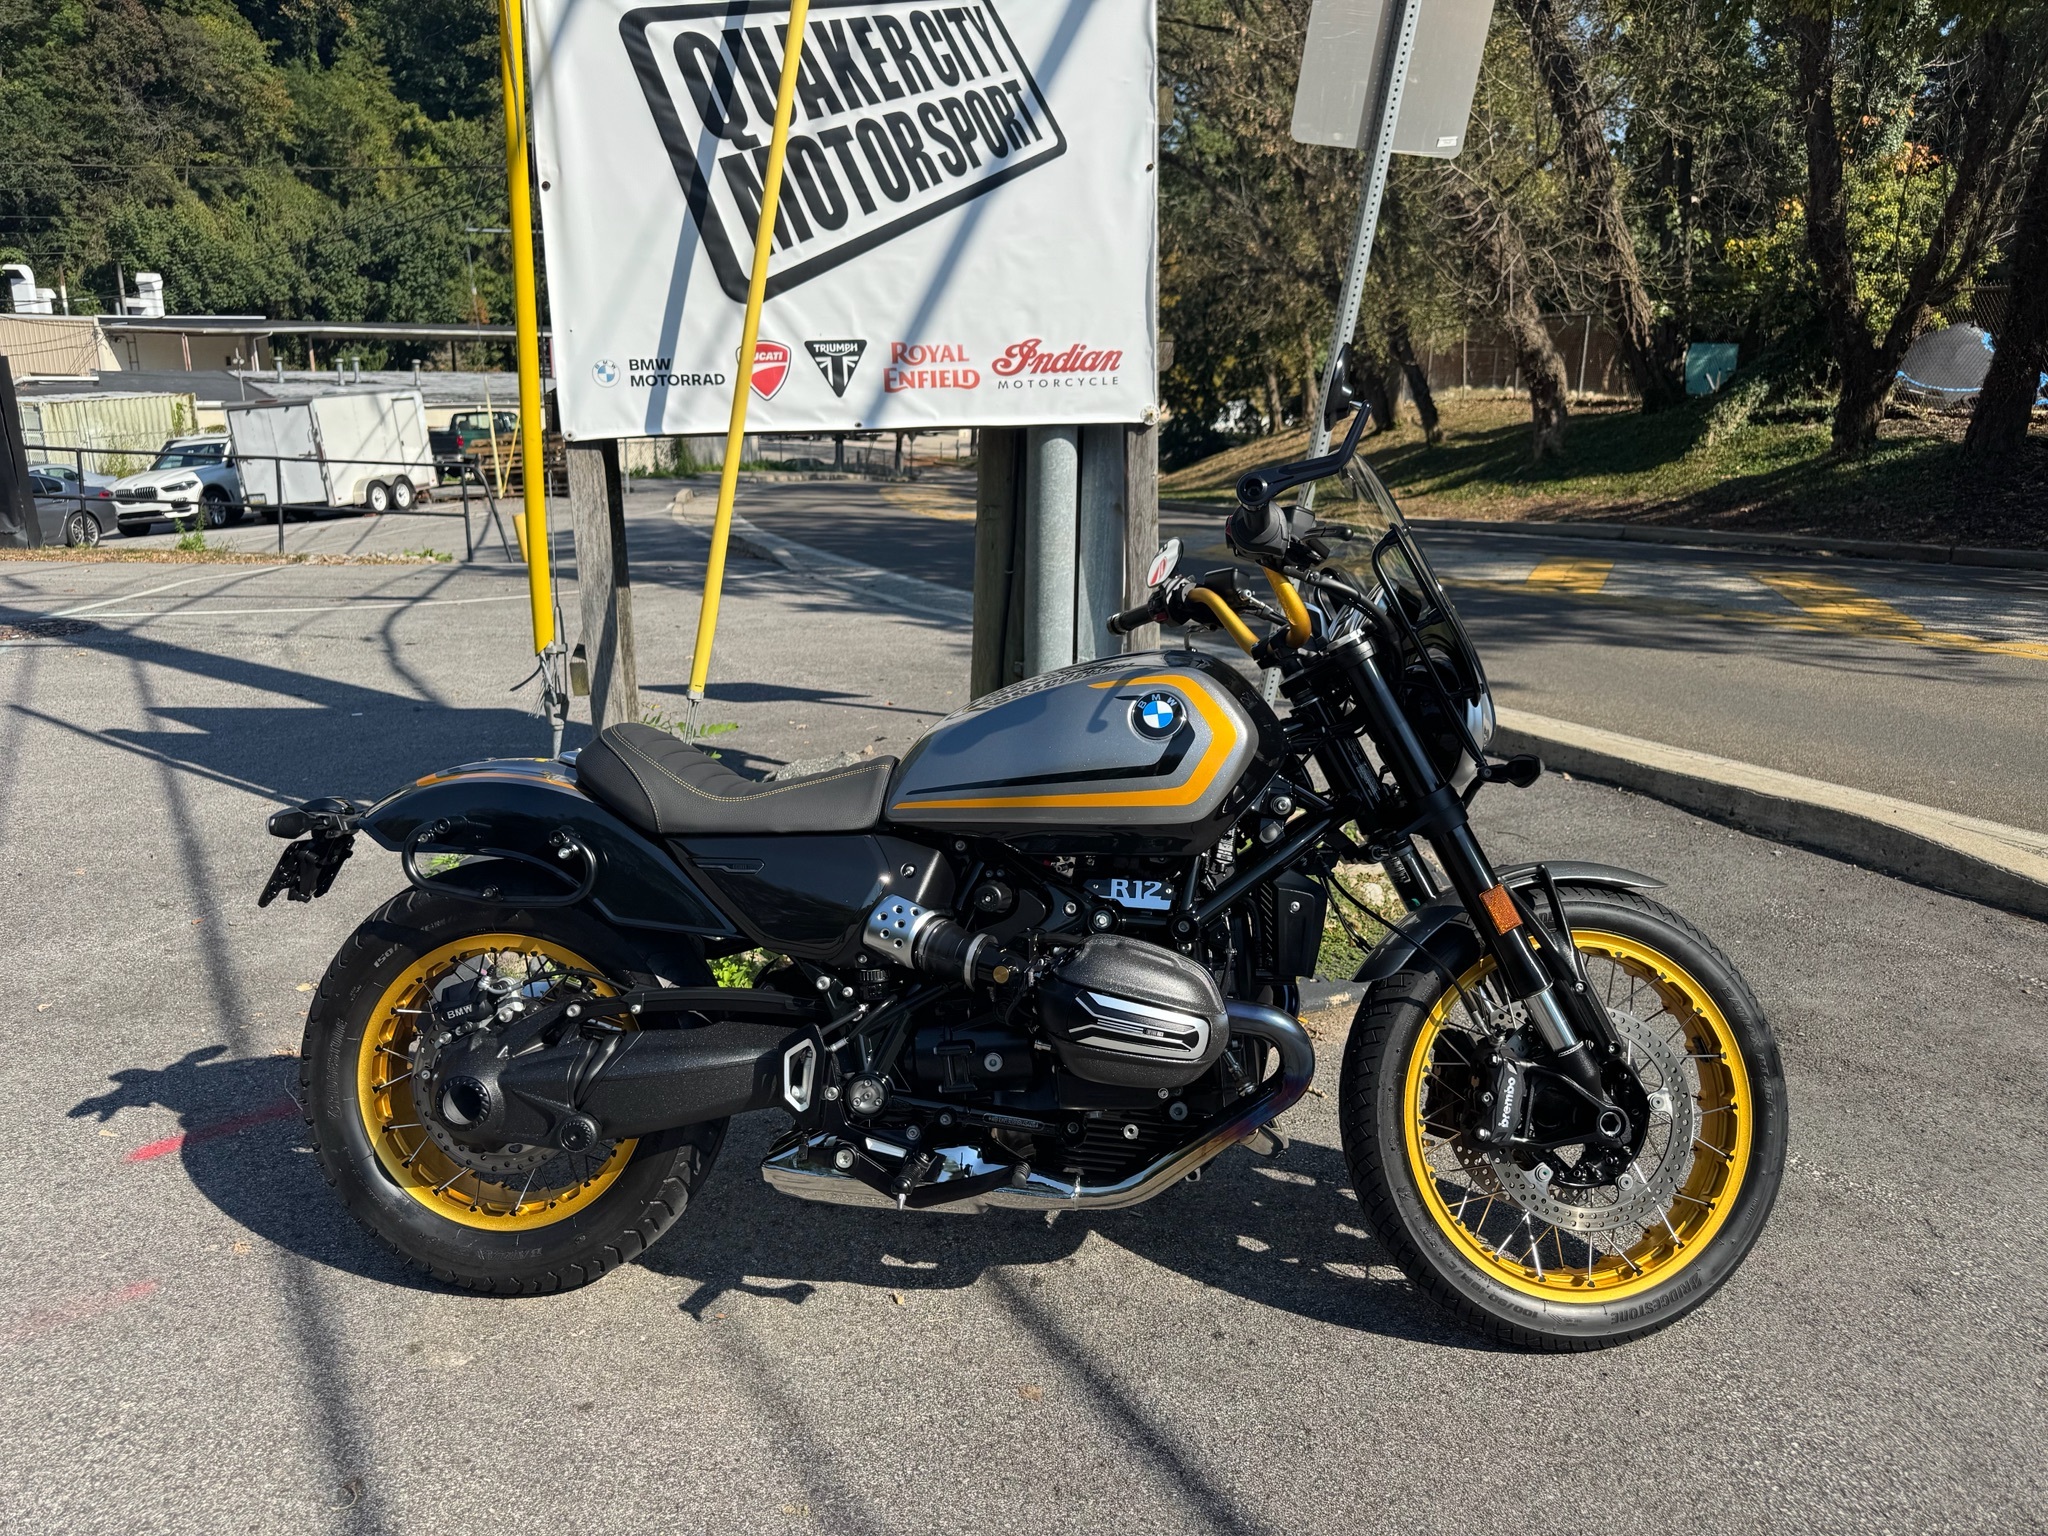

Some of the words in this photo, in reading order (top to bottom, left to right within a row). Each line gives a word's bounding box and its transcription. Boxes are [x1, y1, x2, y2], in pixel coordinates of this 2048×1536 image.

[910, 6, 1008, 88] CITY
[718, 79, 1043, 256] MOTORSPORT
[753, 351, 783, 361] UCATI
[813, 343, 858, 354] TRIUMPH
[891, 341, 969, 366] ROYAL
[991, 338, 1123, 376] Indian
[629, 358, 671, 371] BMW
[630, 373, 726, 387] MOTORRAD
[883, 367, 980, 393] ENFIELD
[997, 376, 1119, 389] MOTORCYCLE
[1137, 693, 1178, 709] BMW
[1110, 879, 1162, 899] R12
[446, 1003, 473, 1019] BMW
[1497, 1076, 1516, 1128] brembo
[1610, 1271, 1703, 1325] BRIDGESTONE
